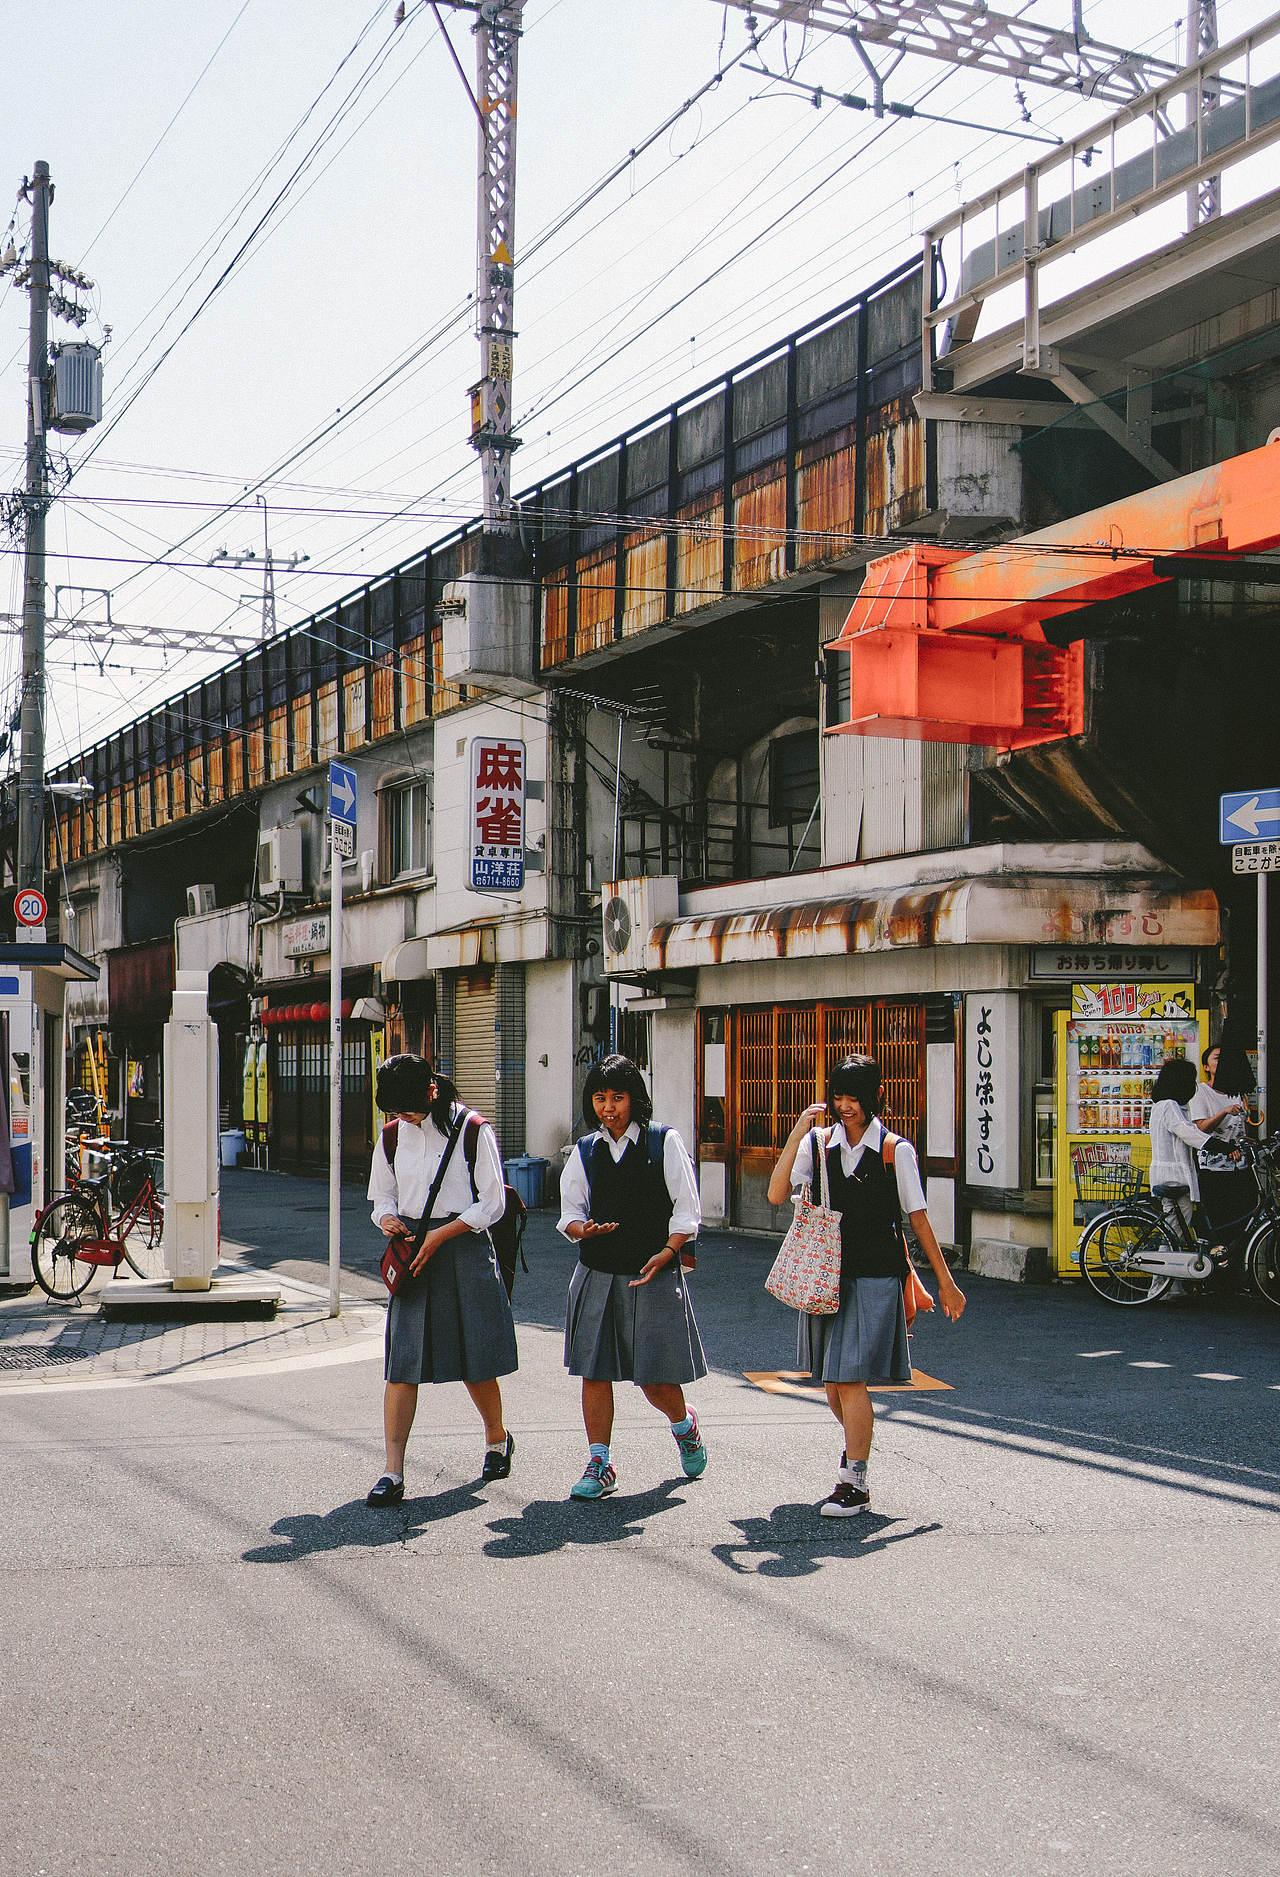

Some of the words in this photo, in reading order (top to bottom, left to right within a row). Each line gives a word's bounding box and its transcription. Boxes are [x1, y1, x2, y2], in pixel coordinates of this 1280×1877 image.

[477, 743, 521, 845] 麻雀
[335, 837, 352, 854] ここから
[475, 846, 522, 859] 貸卓専門
[1235, 844, 1280, 856] 自転車を除
[475, 861, 520, 876] 山洋荘
[22, 899, 39, 916] 20
[1057, 954, 1170, 971] お持ち帰り寿し
[1097, 985, 1137, 1017] 100
[1107, 1023, 1147, 1035] Aloha!
